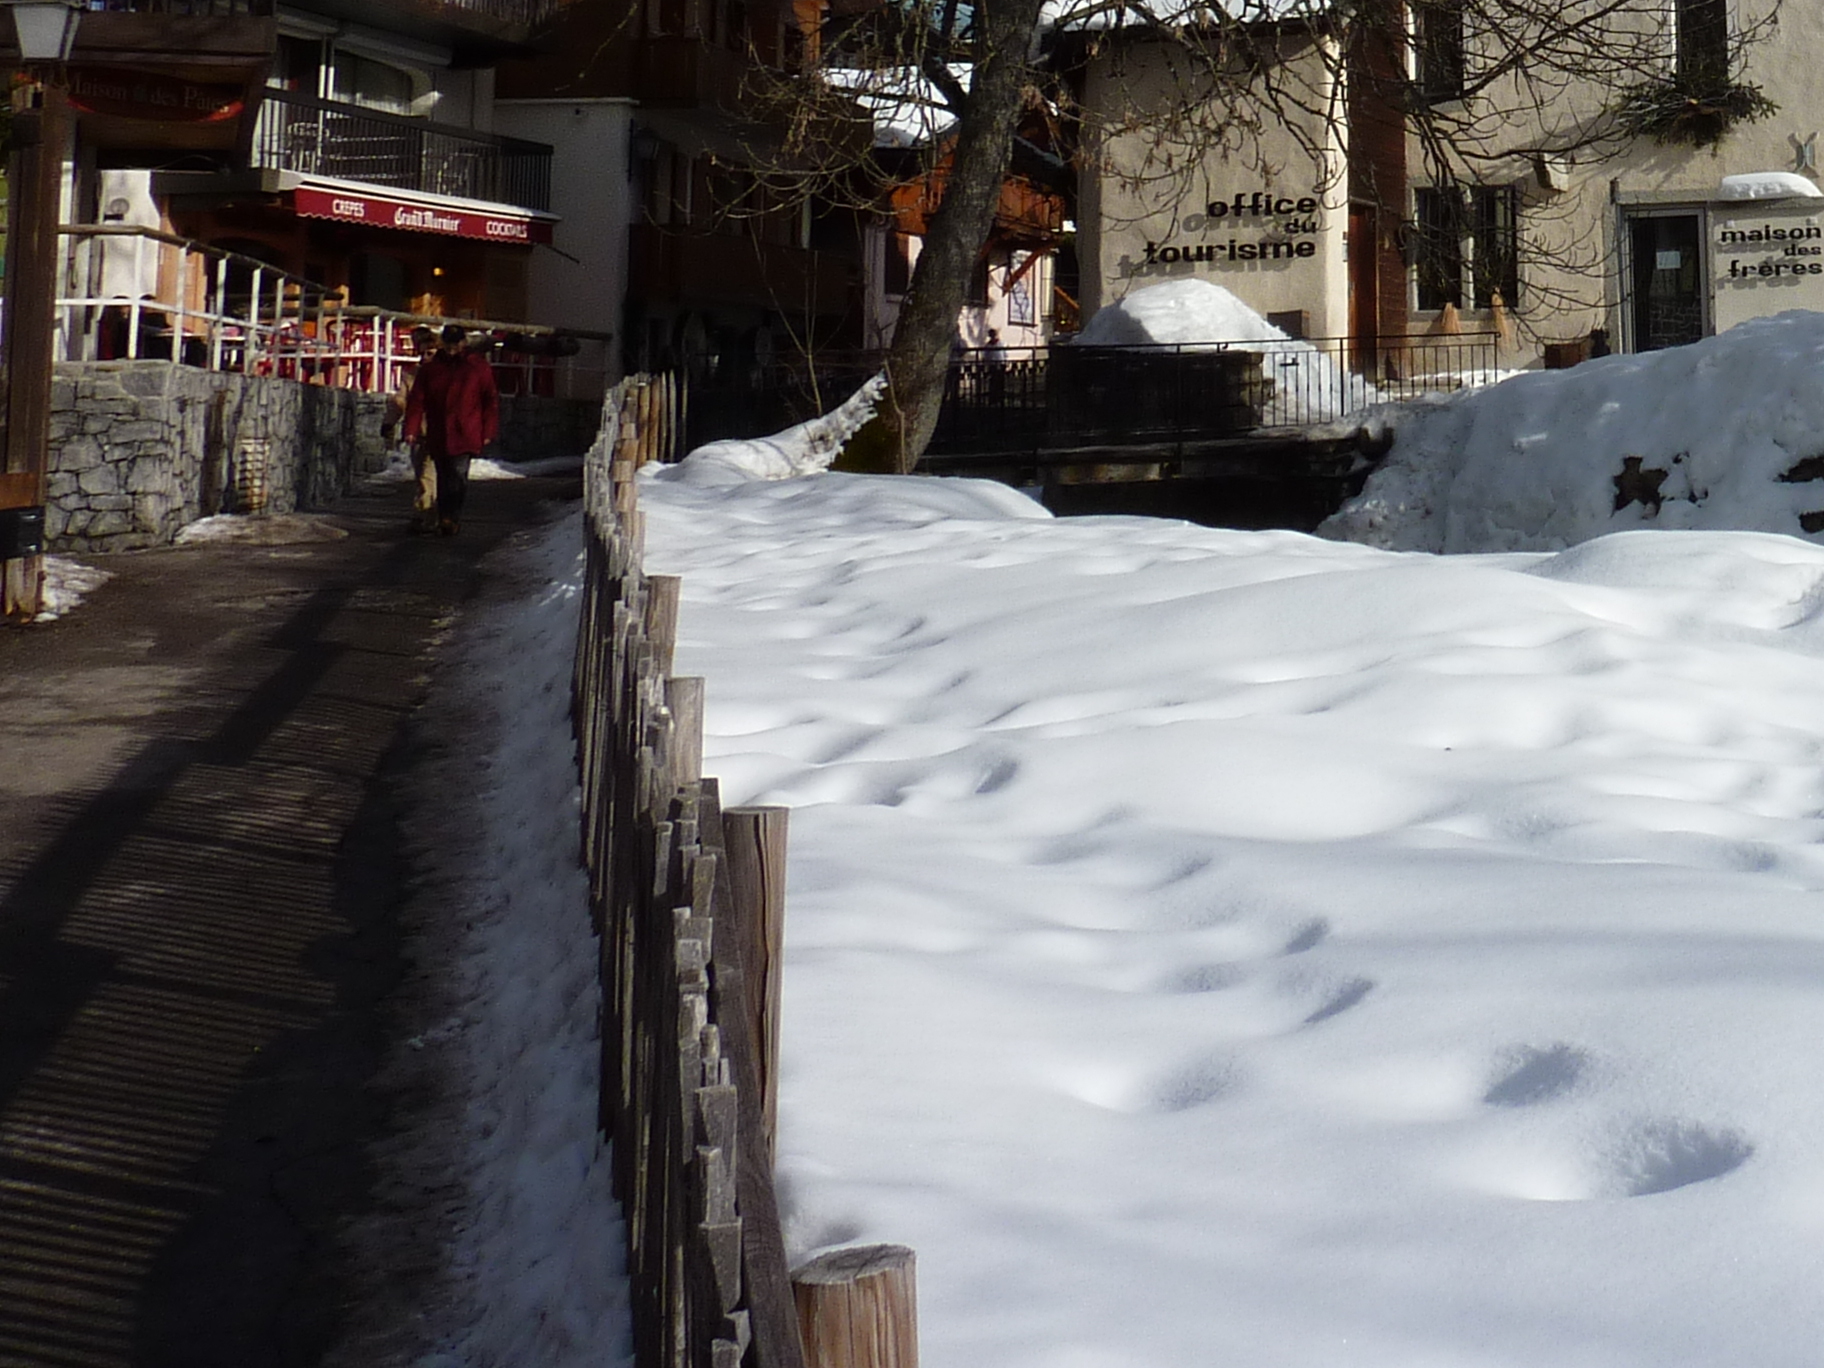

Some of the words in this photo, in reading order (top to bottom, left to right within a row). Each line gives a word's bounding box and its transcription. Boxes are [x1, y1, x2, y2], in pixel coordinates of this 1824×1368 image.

[150, 86, 178, 107] des
[1208, 192, 1316, 217] office
[393, 206, 423, 226] Grand
[422, 210, 460, 232] Marnier
[485, 220, 528, 238] COCKTAILS
[1284, 218, 1316, 234] du
[1720, 225, 1822, 243] maison
[1143, 239, 1316, 265] tourisme
[1784, 243, 1822, 257] des
[1727, 259, 1823, 278] frères
